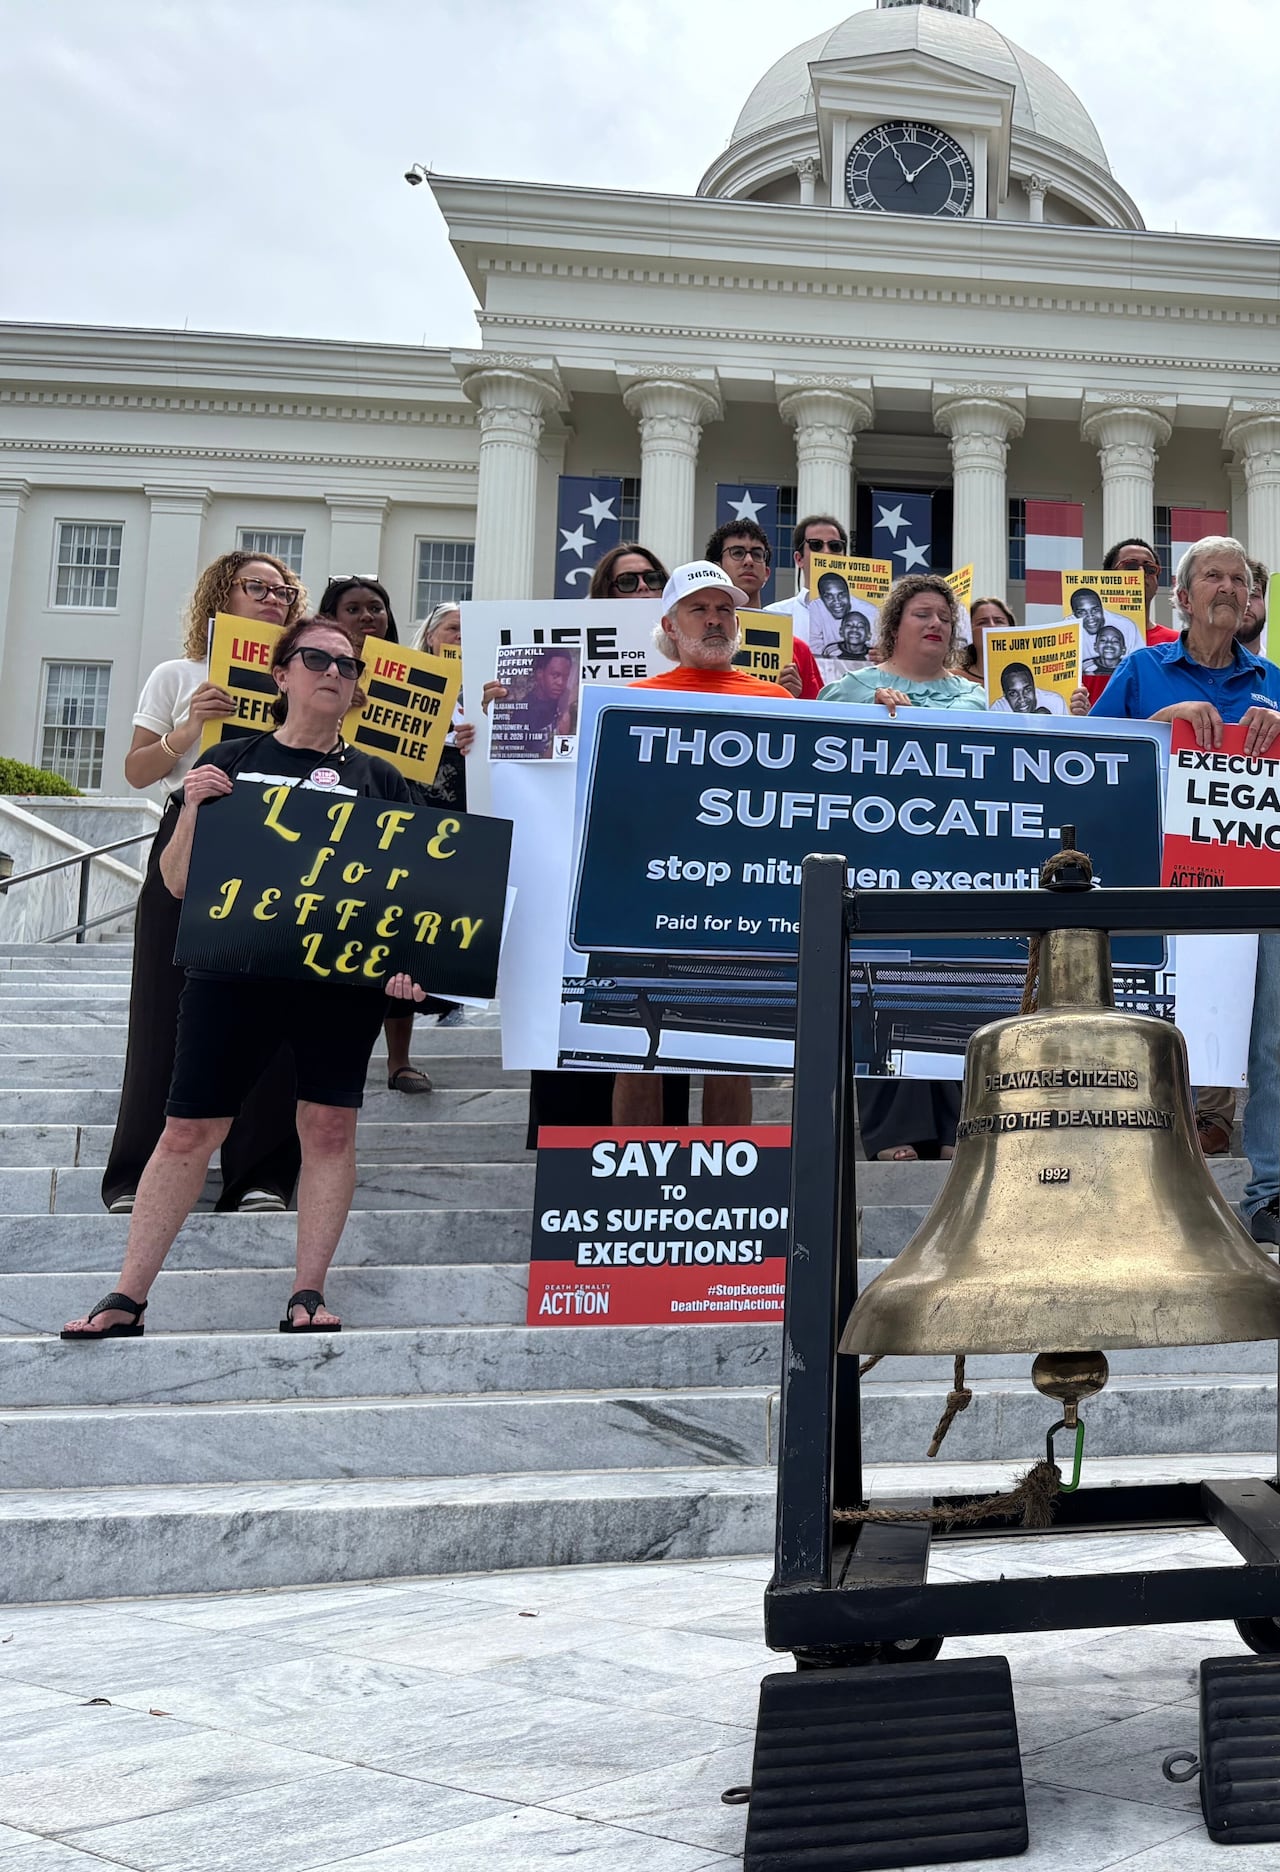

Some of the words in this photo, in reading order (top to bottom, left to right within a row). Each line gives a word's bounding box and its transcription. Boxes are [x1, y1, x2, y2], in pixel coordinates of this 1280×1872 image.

[814, 558, 827, 568] THE
[828, 559, 846, 570] JURY
[848, 561, 870, 572] VOTED
[872, 565, 889, 574] LIFE.
[847, 575, 873, 583] ALABAMA
[856, 583, 879, 591] EXECUTE
[1065, 576, 1079, 584] THE
[1080, 576, 1099, 585] JURY
[1101, 576, 1122, 585] VOTED
[1124, 576, 1141, 585] LIFE.
[991, 639, 1007, 651] THE
[1009, 638, 1030, 651] JURY
[1032, 636, 1057, 649] VOTED
[1058, 632, 1075, 646] LIFE.
[231, 638, 270, 666] LIFE
[443, 649, 457, 659] THE
[498, 649, 523, 657] DON'T
[524, 648, 545, 656] KILL
[621, 651, 646, 659] FOR
[753, 651, 780, 670] FOR
[1032, 653, 1059, 664] ALABAMA
[1059, 650, 1077, 661] PLANS
[373, 657, 408, 682] LIFE
[497, 659, 534, 667] JEFFERY
[608, 664, 648, 678] LEE
[1034, 666, 1041, 675] TO
[1042, 662, 1065, 674] EXECUTE
[1065, 660, 1077, 669] HIM
[500, 677, 512, 685] EE
[1053, 672, 1077, 682] ANYWAY.
[410, 692, 441, 717] FOR
[361, 703, 433, 738] JEFFERY
[400, 738, 429, 762] LEE
[629, 725, 796, 769] THOU
[811, 735, 995, 780] SHALT
[1013, 747, 1130, 786] NOT
[262, 785, 461, 859] LIFE
[695, 787, 1062, 840] SUFFOCATE.
[300, 847, 409, 891] for
[645, 855, 732, 887] stop
[209, 878, 484, 949] JEFFERY
[655, 914, 698, 931] Paid
[703, 914, 732, 932] for
[737, 916, 762, 935] by
[301, 932, 391, 979] LEE
[985, 1070, 1064, 1091] DELAWARE
[1067, 1070, 1138, 1088] CITIZENS
[999, 1113, 1018, 1130] TO
[1021, 1111, 1051, 1128] THE
[1057, 1110, 1113, 1127] DEATH
[1117, 1110, 1176, 1128] PENALTY
[592, 1141, 677, 1178] SAY
[691, 1141, 759, 1177] NO
[1039, 1168, 1070, 1181] 1992
[660, 1185, 687, 1200] TO
[540, 1208, 599, 1233] GAS
[577, 1239, 763, 1265] EXECUTIONS!
[539, 1290, 610, 1315] ACTION
